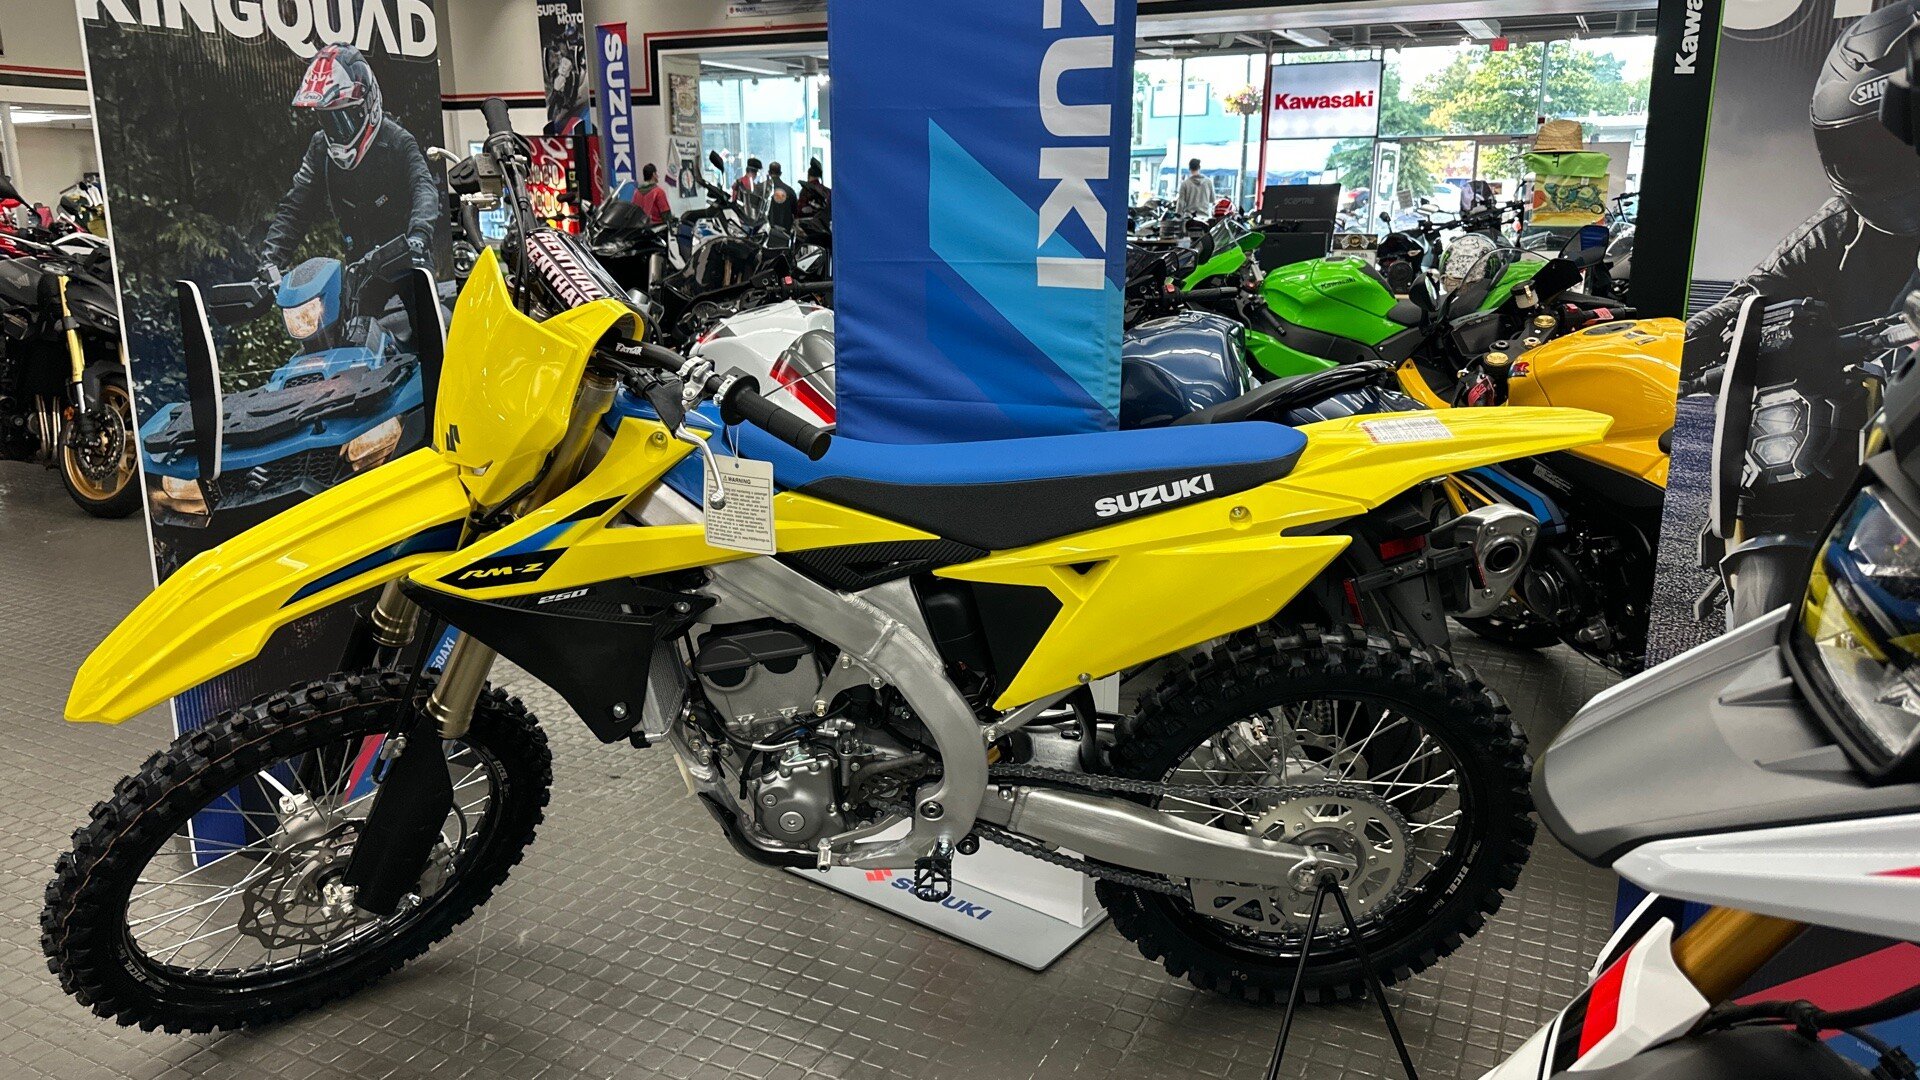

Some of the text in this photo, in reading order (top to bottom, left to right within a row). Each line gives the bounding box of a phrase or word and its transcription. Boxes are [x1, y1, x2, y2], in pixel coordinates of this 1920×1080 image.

[537, 3, 568, 17] SUPER
[557, 12, 584, 25] MOTO
[604, 33, 634, 183] SUZUKI
[1274, 90, 1374, 111] Kawasaki
[535, 232, 605, 302] RENTHAL
[1320, 278, 1356, 290] Kawasaki
[1094, 473, 1215, 517] SUZUKI
[458, 562, 544, 581] RM-Z
[537, 587, 590, 605] 250
[1444, 865, 1469, 895] EXCEL
[891, 877, 992, 920] SUUKI
